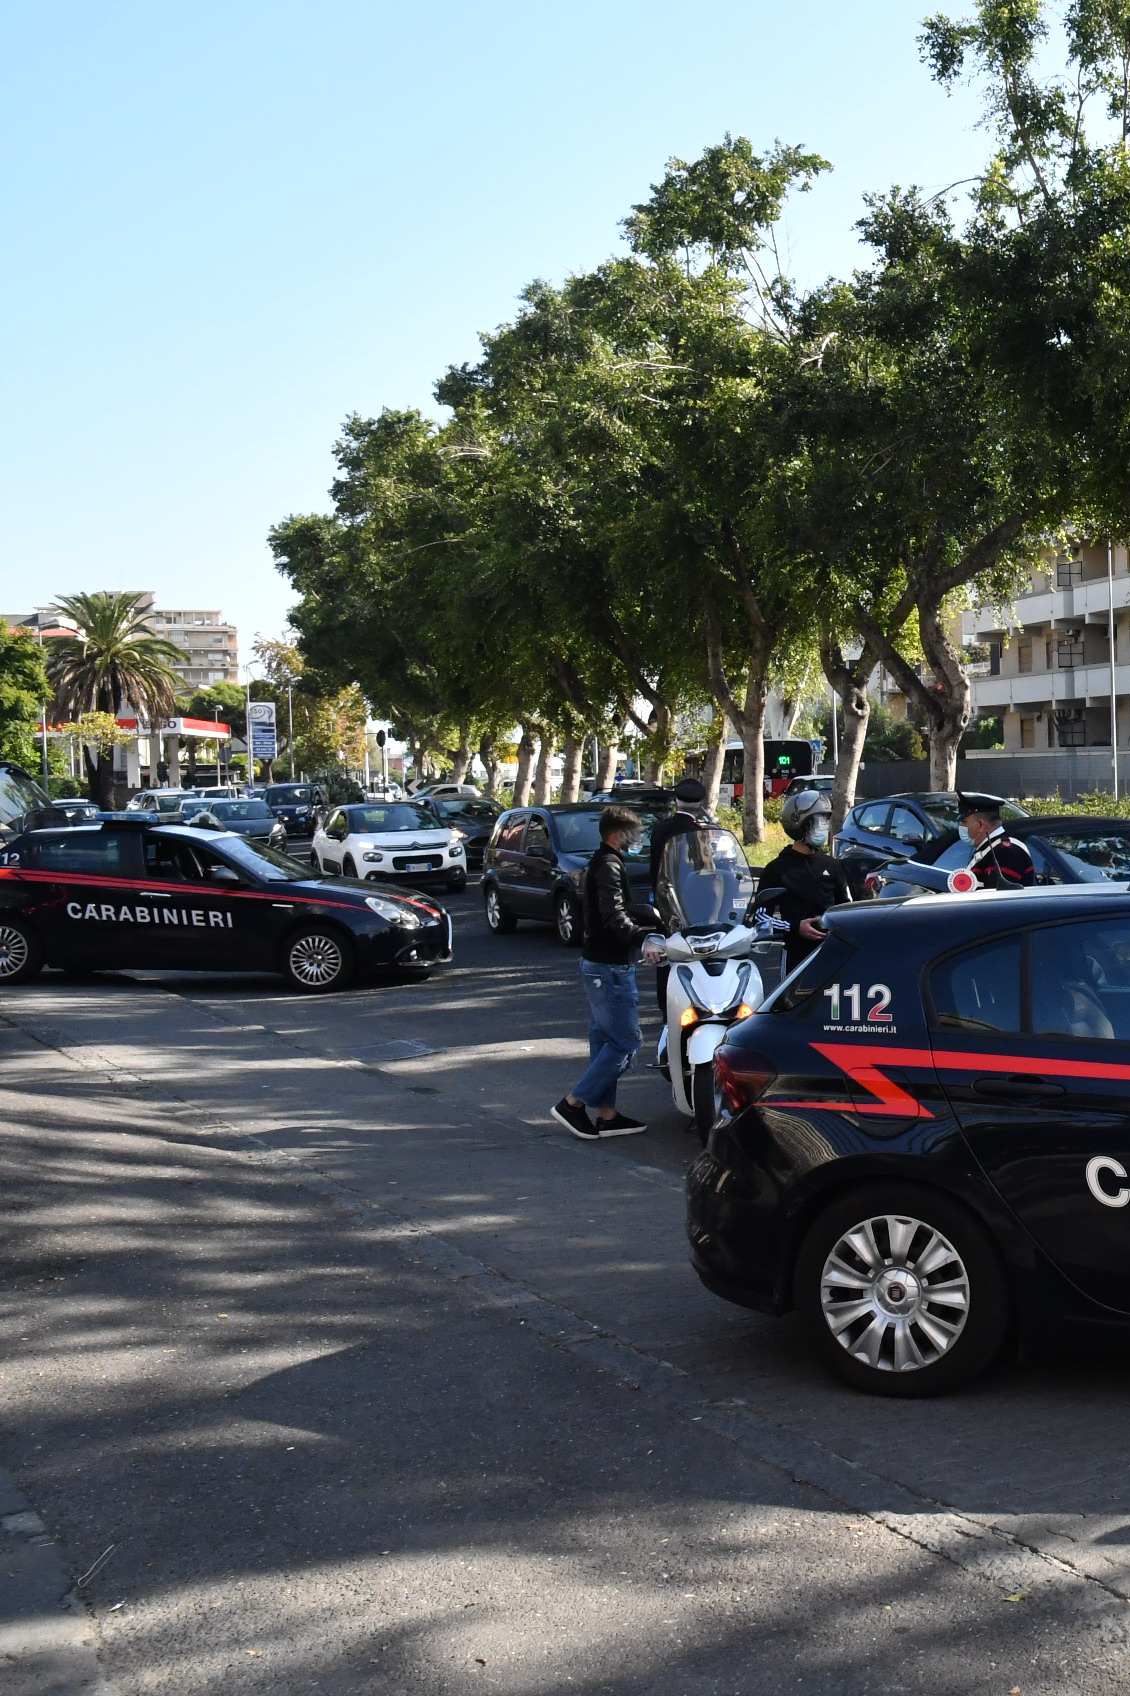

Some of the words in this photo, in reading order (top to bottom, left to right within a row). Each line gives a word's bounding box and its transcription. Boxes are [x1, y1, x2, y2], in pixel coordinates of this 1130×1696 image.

[778, 756, 790, 765] 101
[67, 902, 233, 928] CARABINIERI
[824, 984, 893, 1021] 112
[823, 1025, 897, 1034] www.carabinieri.it
